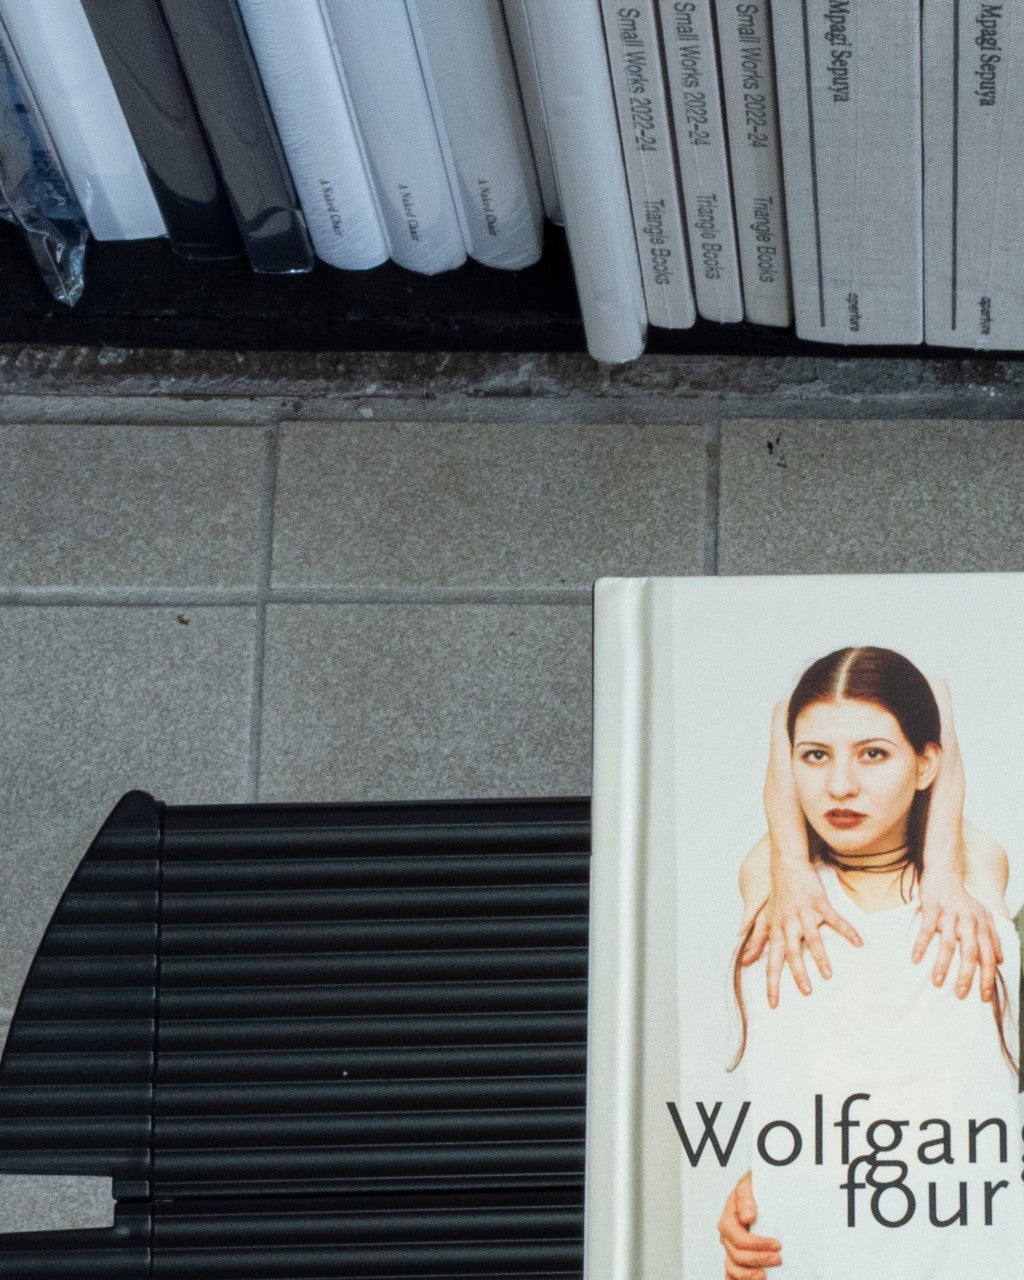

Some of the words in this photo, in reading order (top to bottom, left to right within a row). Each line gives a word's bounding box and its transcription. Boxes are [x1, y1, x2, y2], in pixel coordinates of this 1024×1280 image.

[619, 8, 645, 47] Small
[674, 2, 699, 42] Small
[736, 3, 761, 43] Small
[975, 4, 1001, 51] Mpagi
[624, 50, 648, 94] Works
[680, 44, 703, 88] Works
[739, 46, 763, 91] Works
[827, 48, 851, 103] Sepuya
[975, 53, 1001, 107] Sepuya
[630, 98, 657, 152] 2022-24
[684, 92, 711, 147] 2022-24
[744, 93, 769, 149] 2022-24
[643, 199, 665, 246] Triangle
[695, 193, 717, 240] Triangle
[750, 196, 773, 244] Triangle
[651, 247, 672, 286] Books
[701, 241, 722, 281] Books
[756, 245, 776, 284] Books
[840, 1153, 1009, 1230] four
